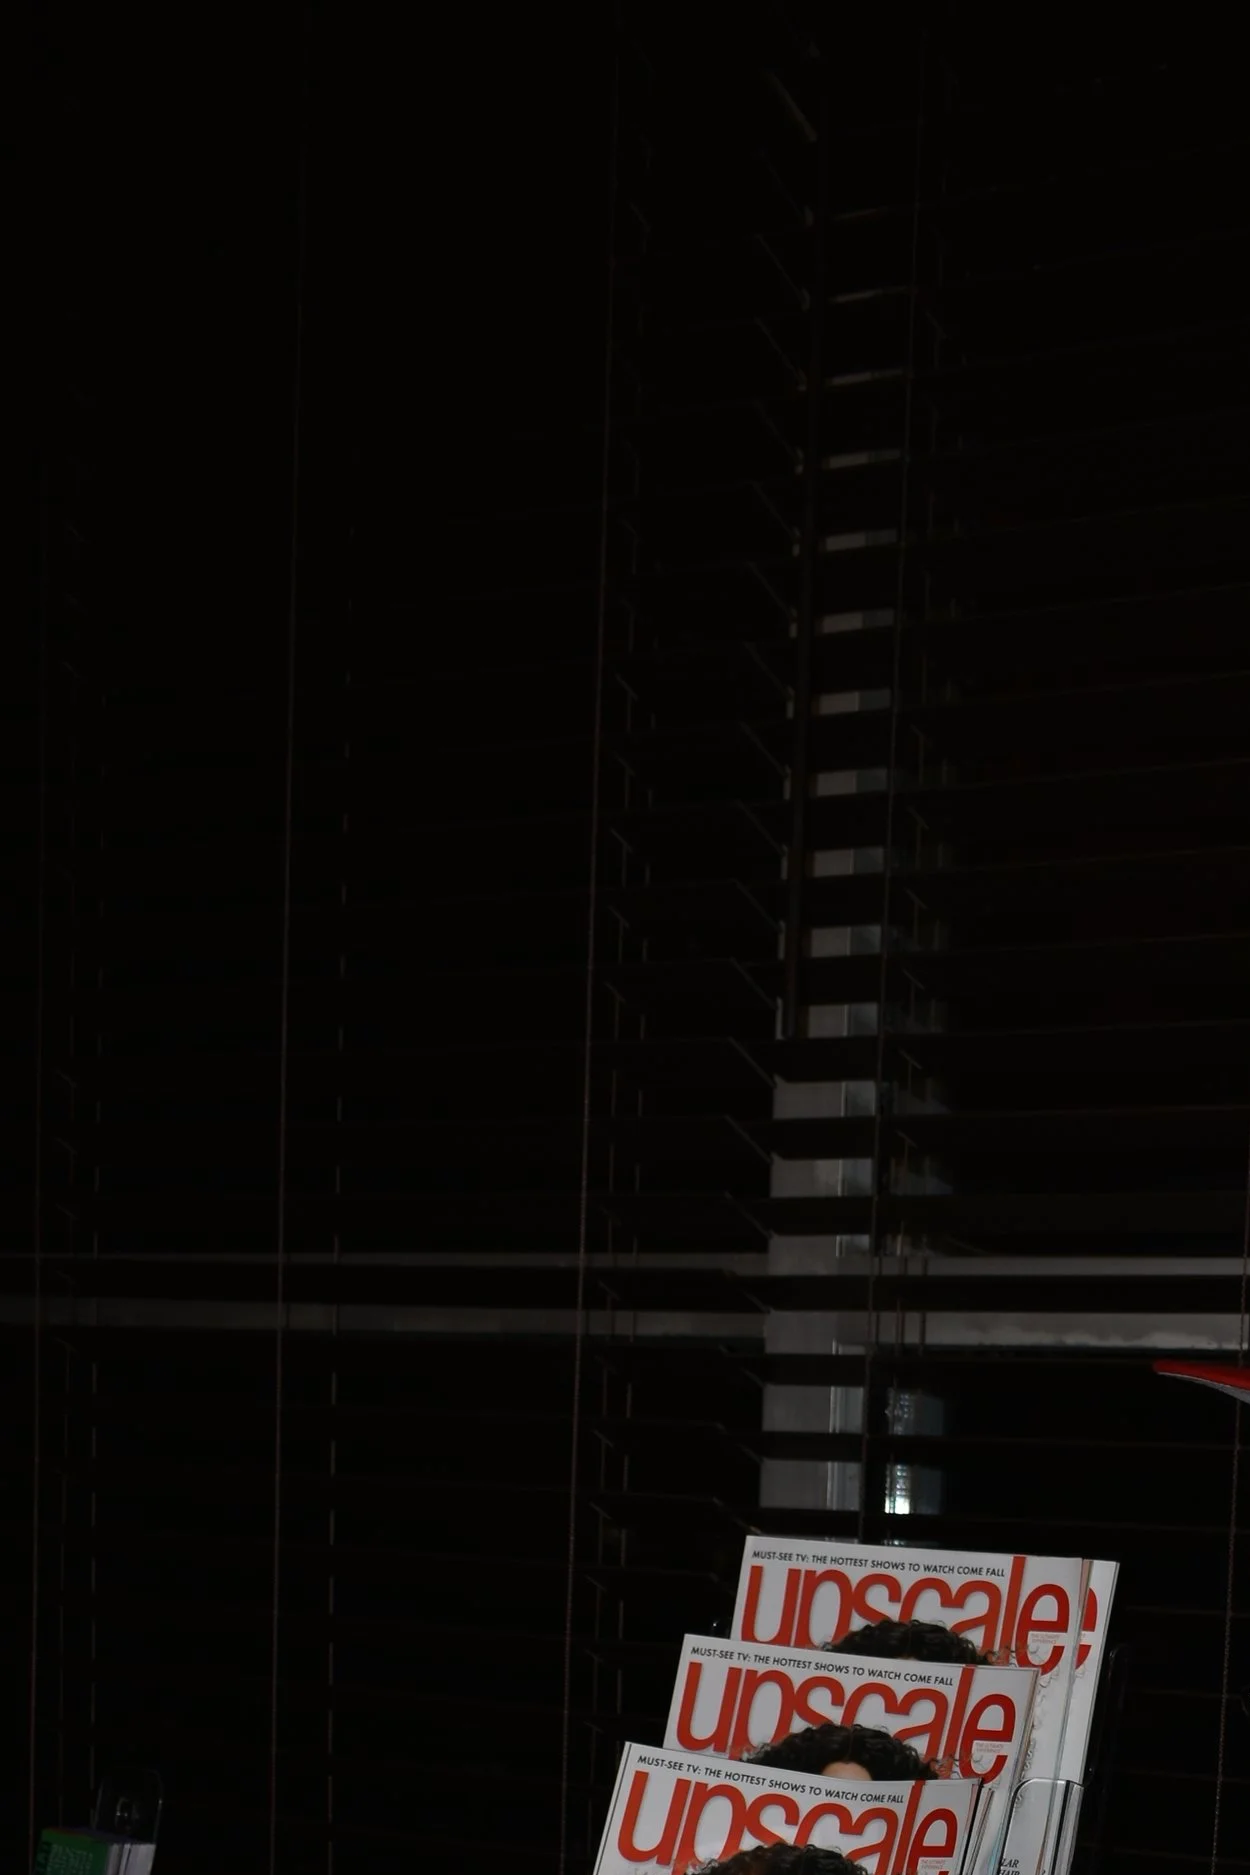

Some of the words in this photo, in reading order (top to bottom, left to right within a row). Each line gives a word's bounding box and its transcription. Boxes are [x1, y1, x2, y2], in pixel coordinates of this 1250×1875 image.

[752, 1551, 793, 1562] MUST-SEE
[796, 1554, 809, 1562] TV:
[812, 1555, 827, 1564] THE
[830, 1557, 868, 1568] HOTTEST
[871, 1560, 905, 1571] SHOWS
[908, 1563, 921, 1572] TO
[923, 1564, 955, 1575] WATCH
[957, 1566, 983, 1576] COME
[986, 1567, 1005, 1577] FALL
[741, 1556, 1070, 1675] upscale
[691, 1646, 734, 1660] MUST-SEE
[736, 1652, 751, 1662] TV:
[754, 1655, 770, 1665] THE
[773, 1656, 811, 1670] HOTTEST
[814, 1663, 850, 1674] SHOWS
[852, 1666, 866, 1676] TO
[868, 1669, 901, 1680] WATCH
[903, 1672, 931, 1683] COME
[934, 1675, 954, 1686] FALL
[676, 1664, 1016, 1783] upscale
[637, 1755, 684, 1772] MUST-SEE
[687, 1764, 702, 1775] TV:
[704, 1767, 723, 1779] THE
[725, 1771, 766, 1786] HOTTEST
[768, 1779, 807, 1794] SHOWS
[809, 1786, 822, 1796] TO
[825, 1788, 858, 1801] WATCH
[860, 1792, 885, 1803] COME
[887, 1794, 904, 1804] FALL
